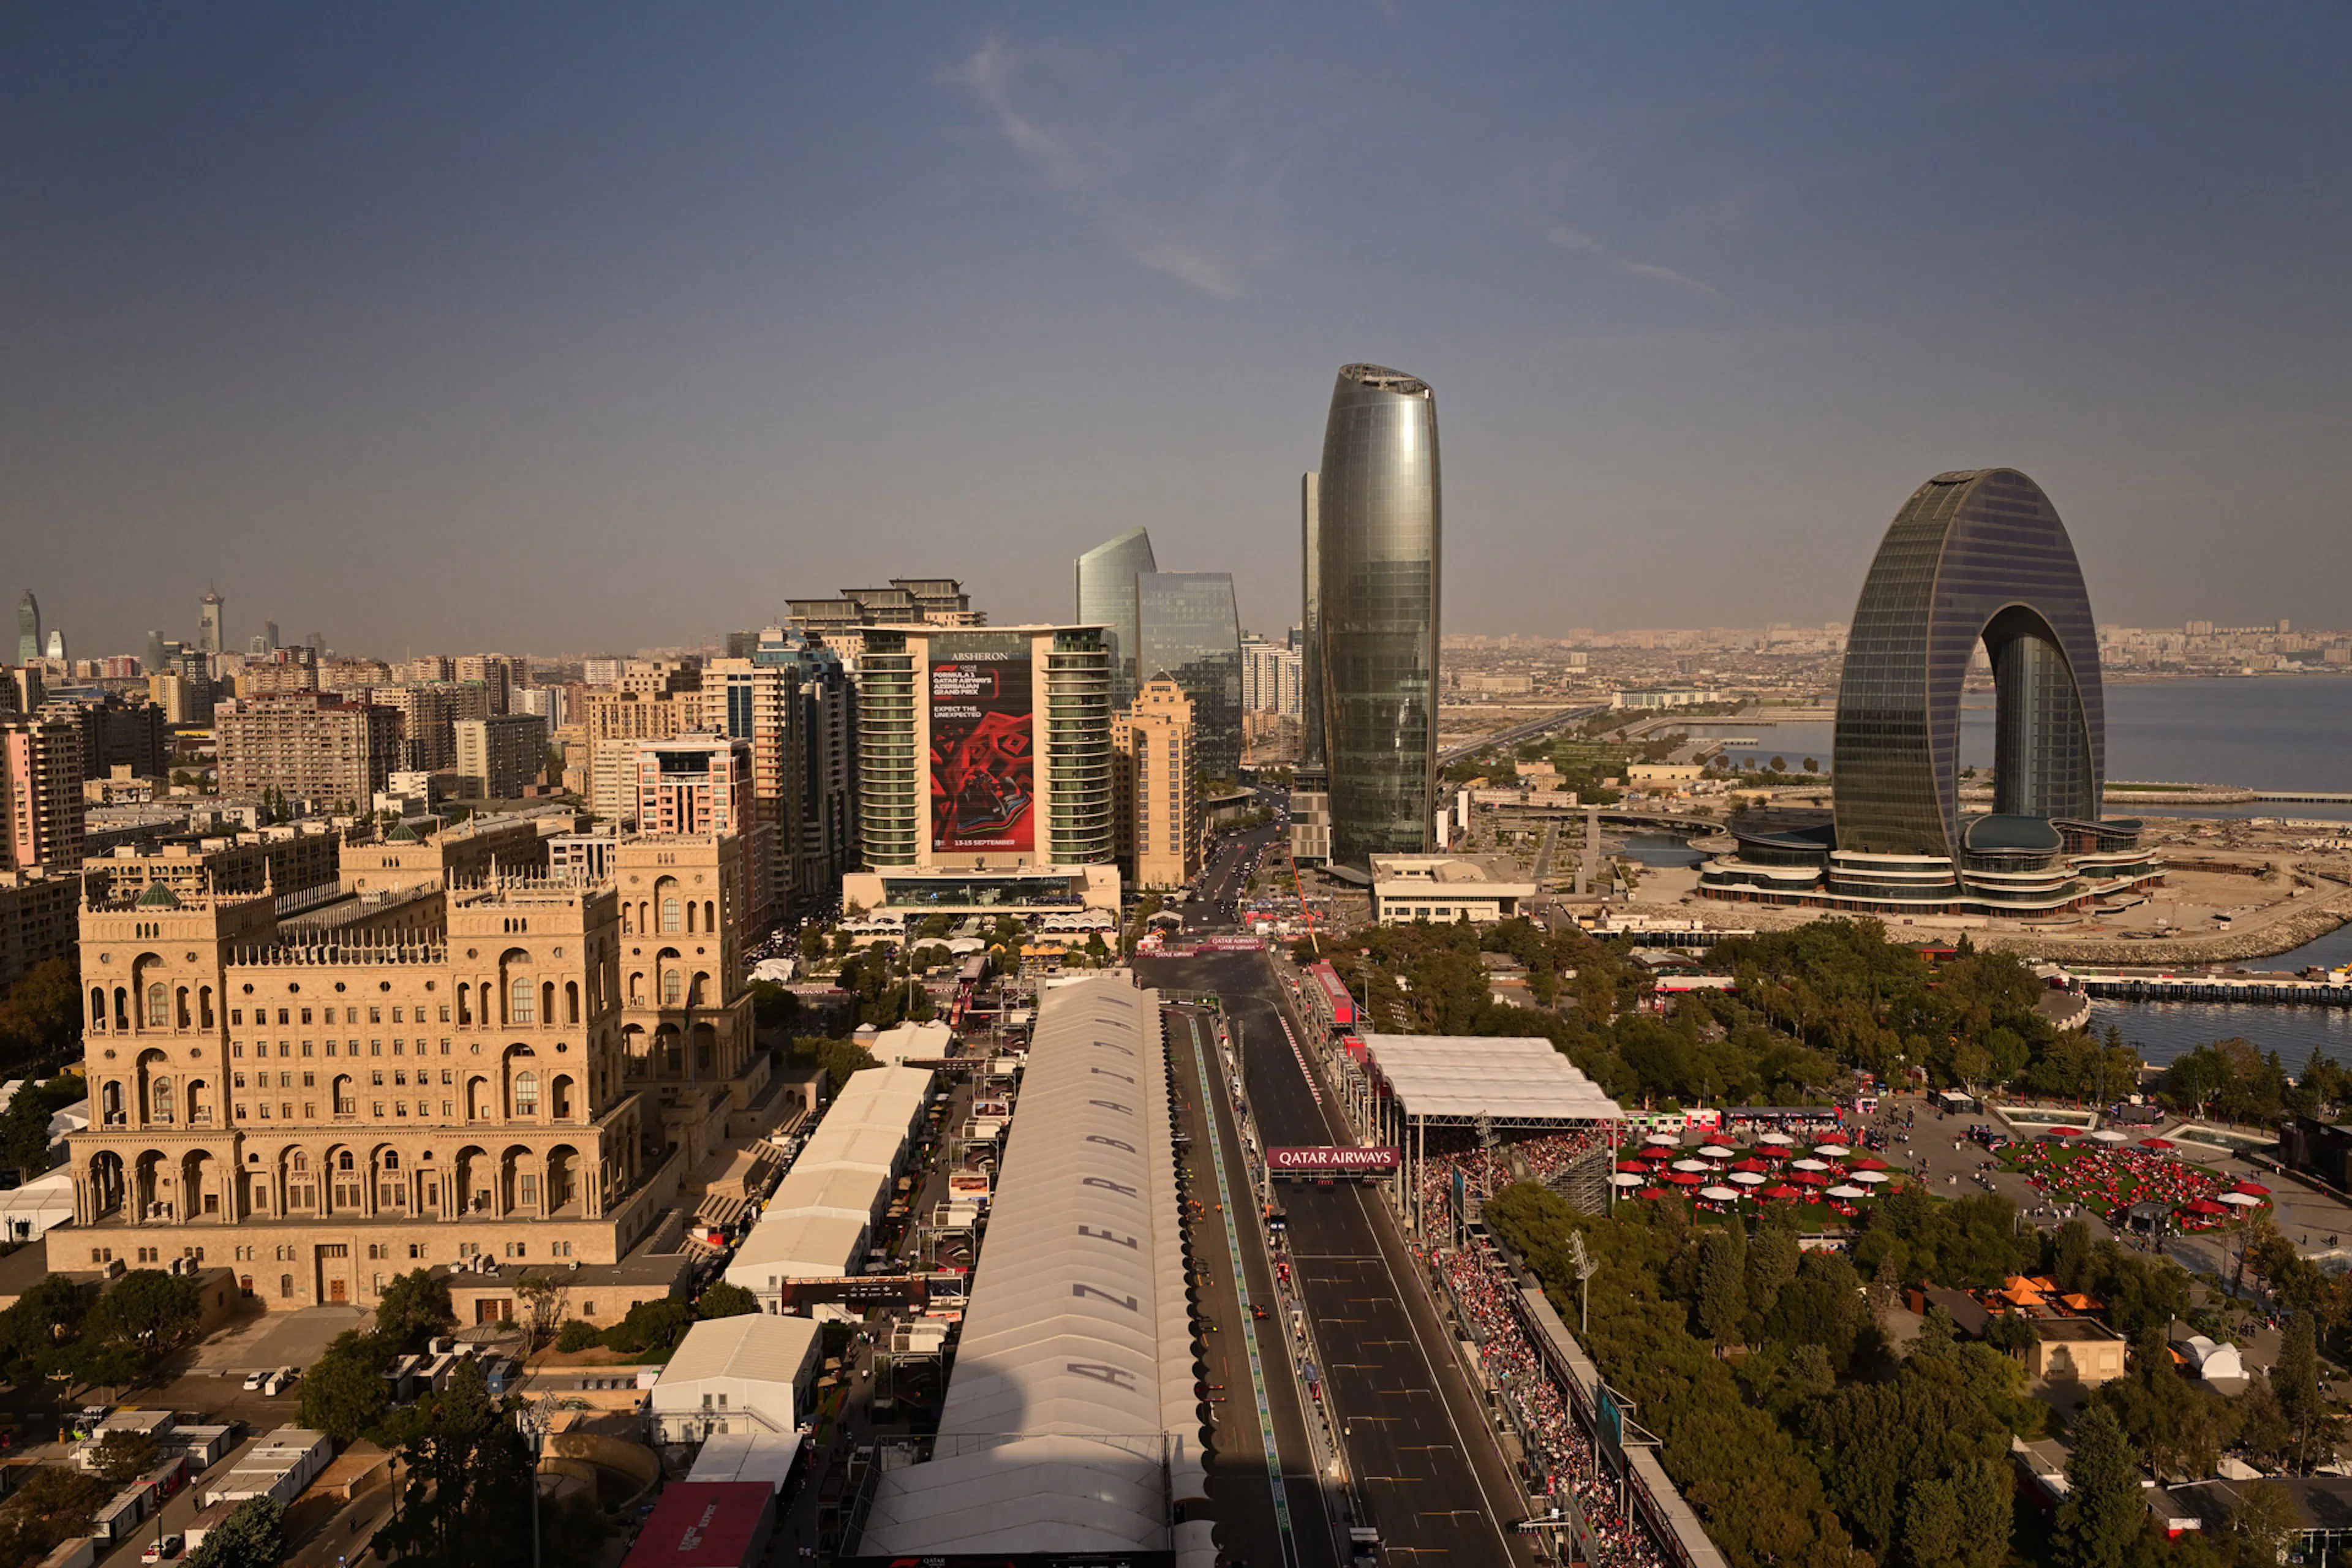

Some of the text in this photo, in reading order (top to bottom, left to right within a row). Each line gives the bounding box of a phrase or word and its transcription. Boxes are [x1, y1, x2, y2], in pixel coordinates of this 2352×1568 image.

[951, 652, 1008, 661] ABSHERON
[1279, 1151, 1392, 1166] QATAR AIRWAYS
